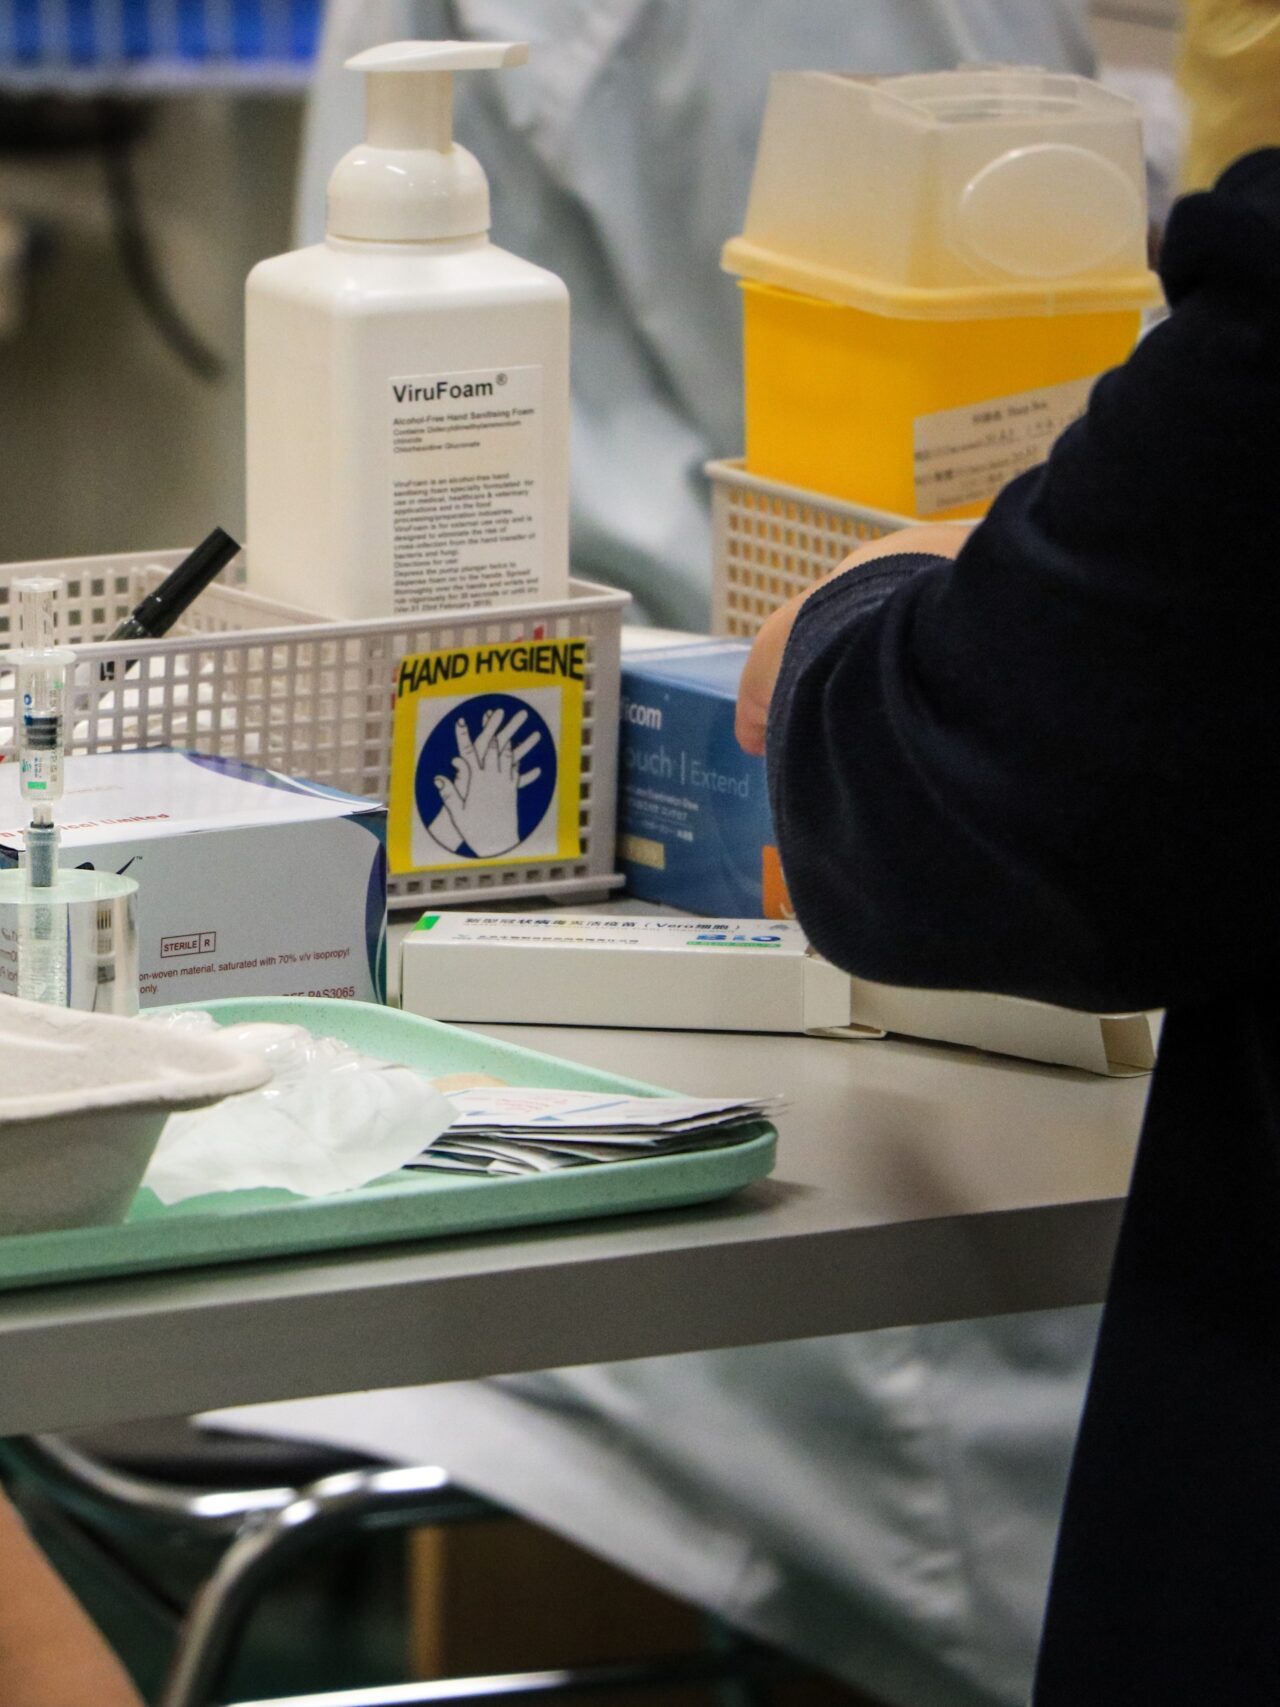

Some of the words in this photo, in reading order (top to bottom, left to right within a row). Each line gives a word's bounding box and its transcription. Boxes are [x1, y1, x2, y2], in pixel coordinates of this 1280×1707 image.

[393, 416, 444, 425] Alcohol-Free
[512, 408, 535, 416] Foam
[397, 653, 469, 698] HAND
[476, 643, 586, 681] HYGIENE
[628, 703, 662, 730] com
[690, 760, 750, 798] Extend
[164, 940, 198, 952] STERILE
[204, 939, 210, 947] R
[139, 968, 178, 981] on-woven
[218, 958, 258, 972] saturated
[260, 957, 276, 967] with
[278, 954, 297, 965] 70%
[300, 952, 311, 961] v/v
[313, 947, 350, 960] isopropyl
[307, 985, 355, 998] PAS3065
